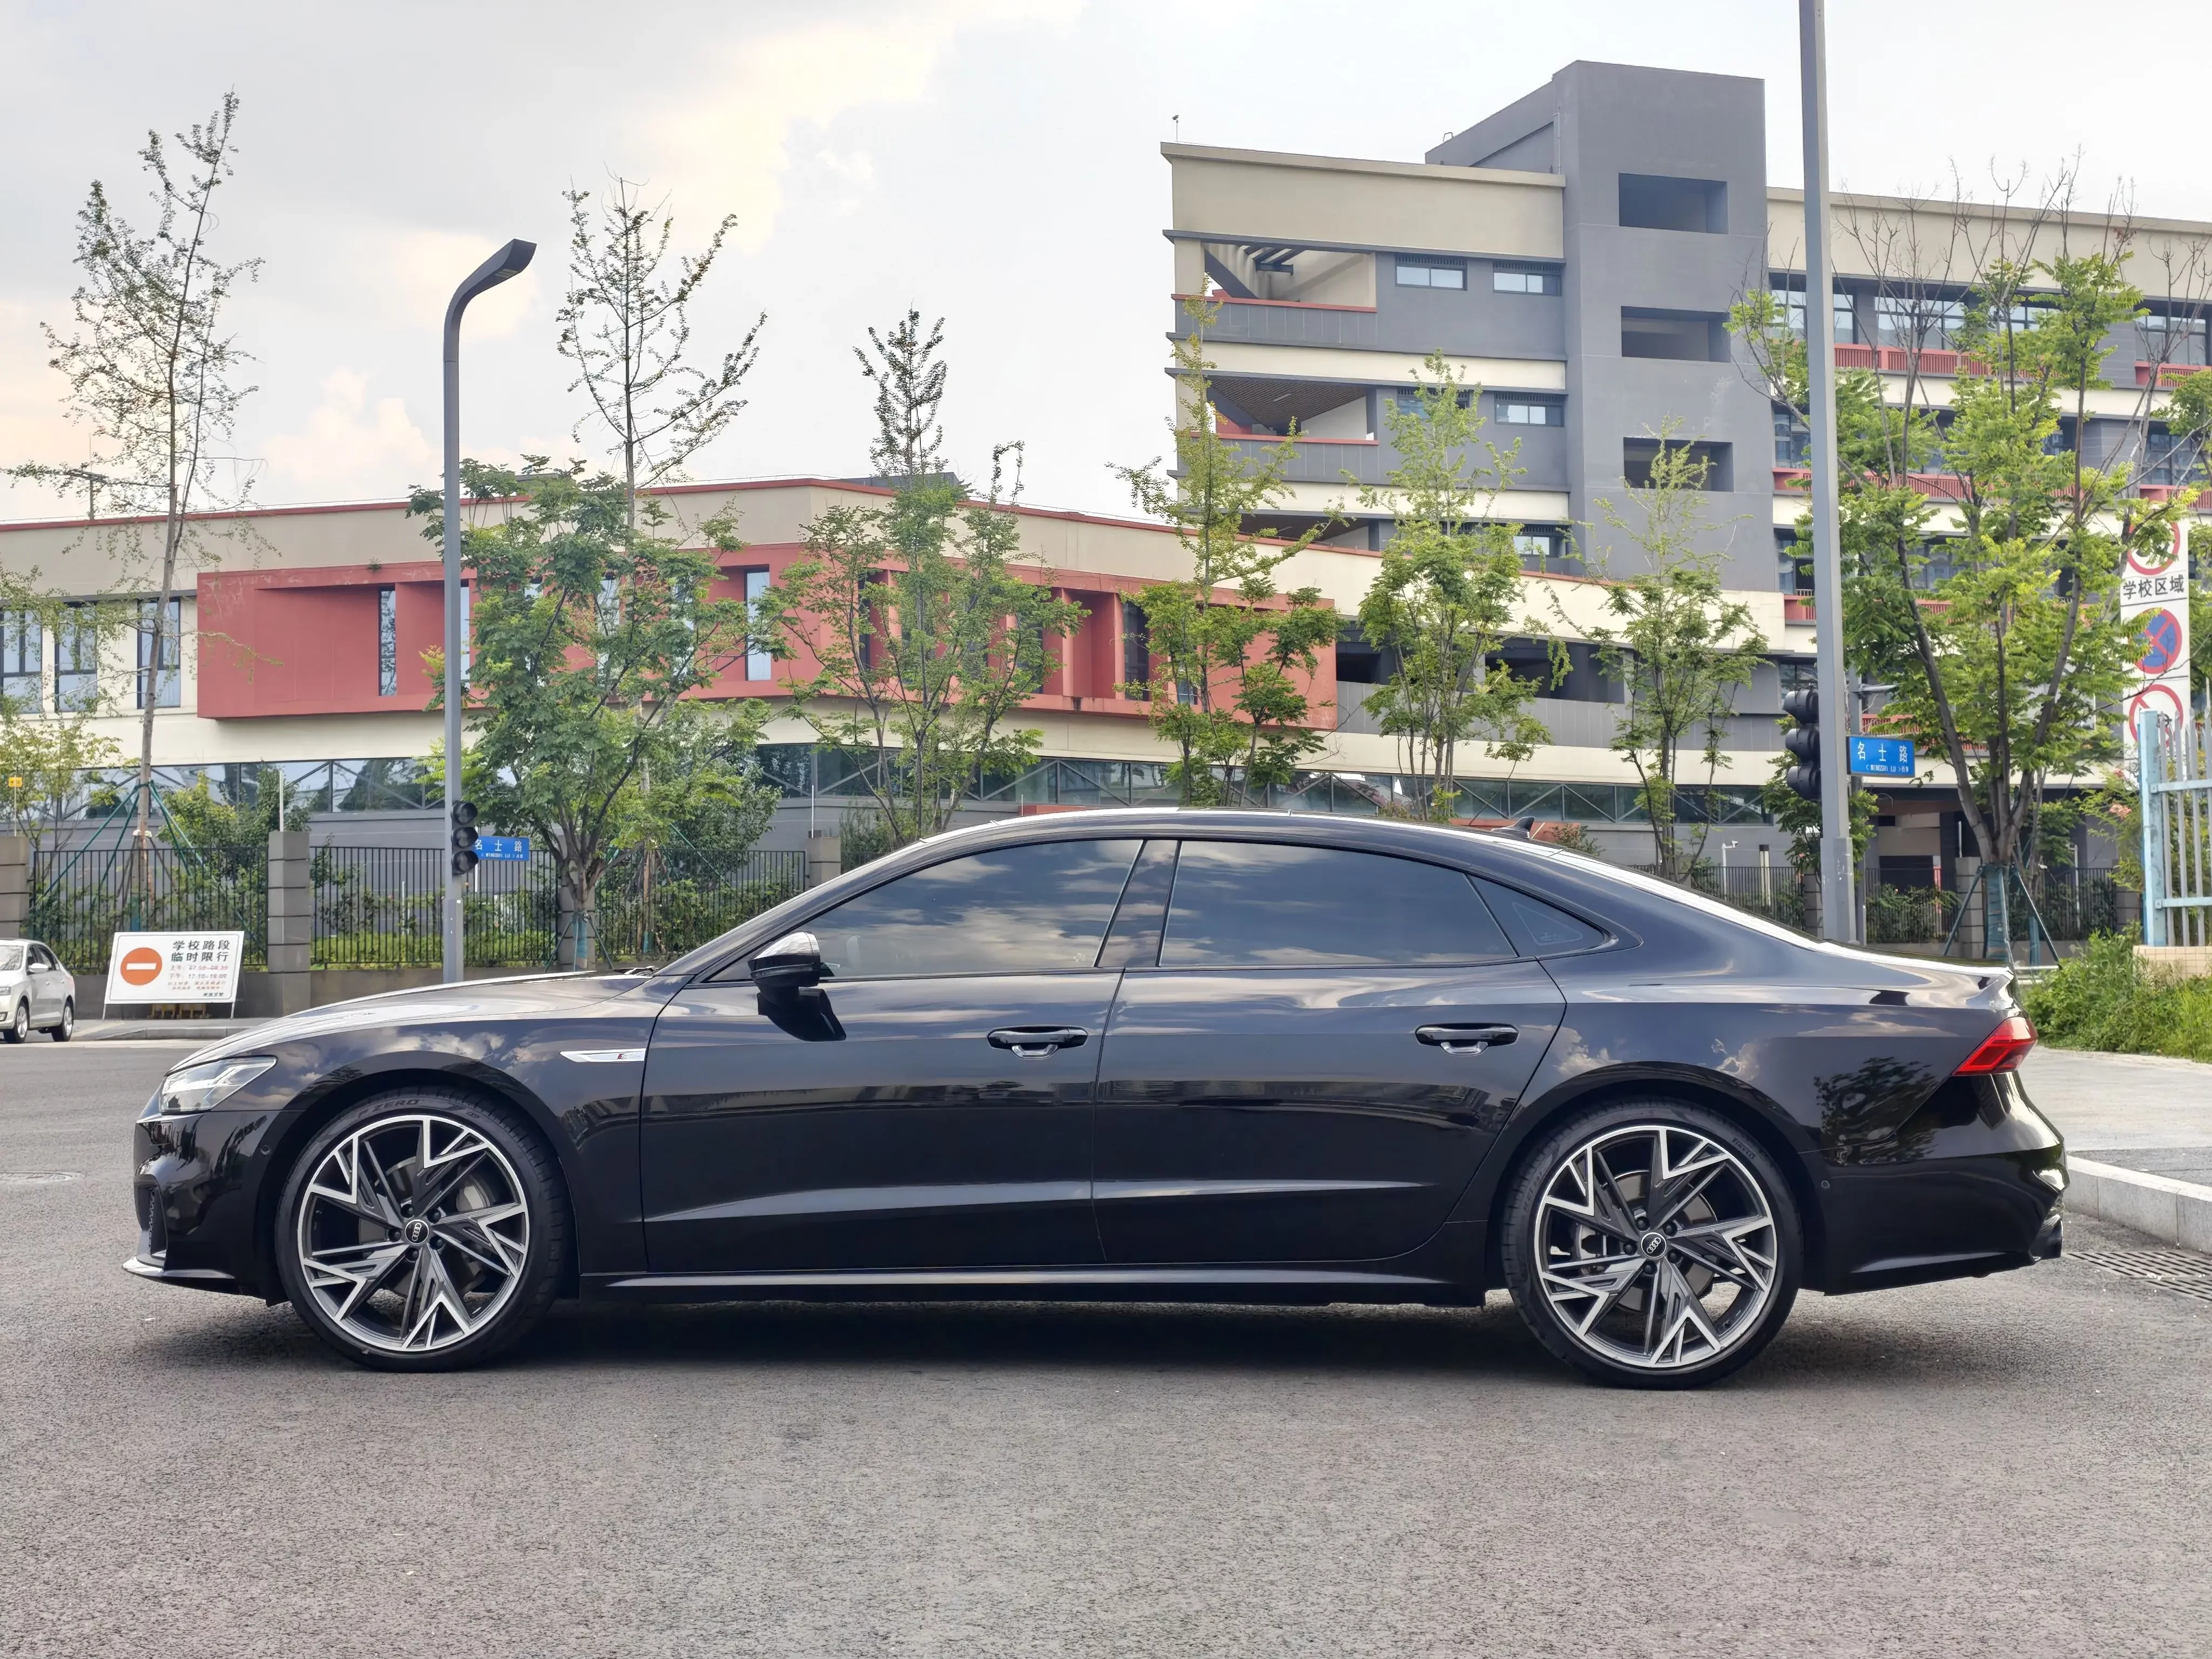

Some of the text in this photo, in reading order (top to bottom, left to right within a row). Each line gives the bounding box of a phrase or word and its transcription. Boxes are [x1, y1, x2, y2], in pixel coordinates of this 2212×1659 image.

[2123, 574, 2184, 599] 学校区域
[1858, 741, 1908, 764] 名士路
[475, 839, 522, 853] 名士路
[172, 940, 230, 950] 学校路段
[171, 952, 229, 962] 临时限行
[373, 1100, 420, 1112] ZERO
